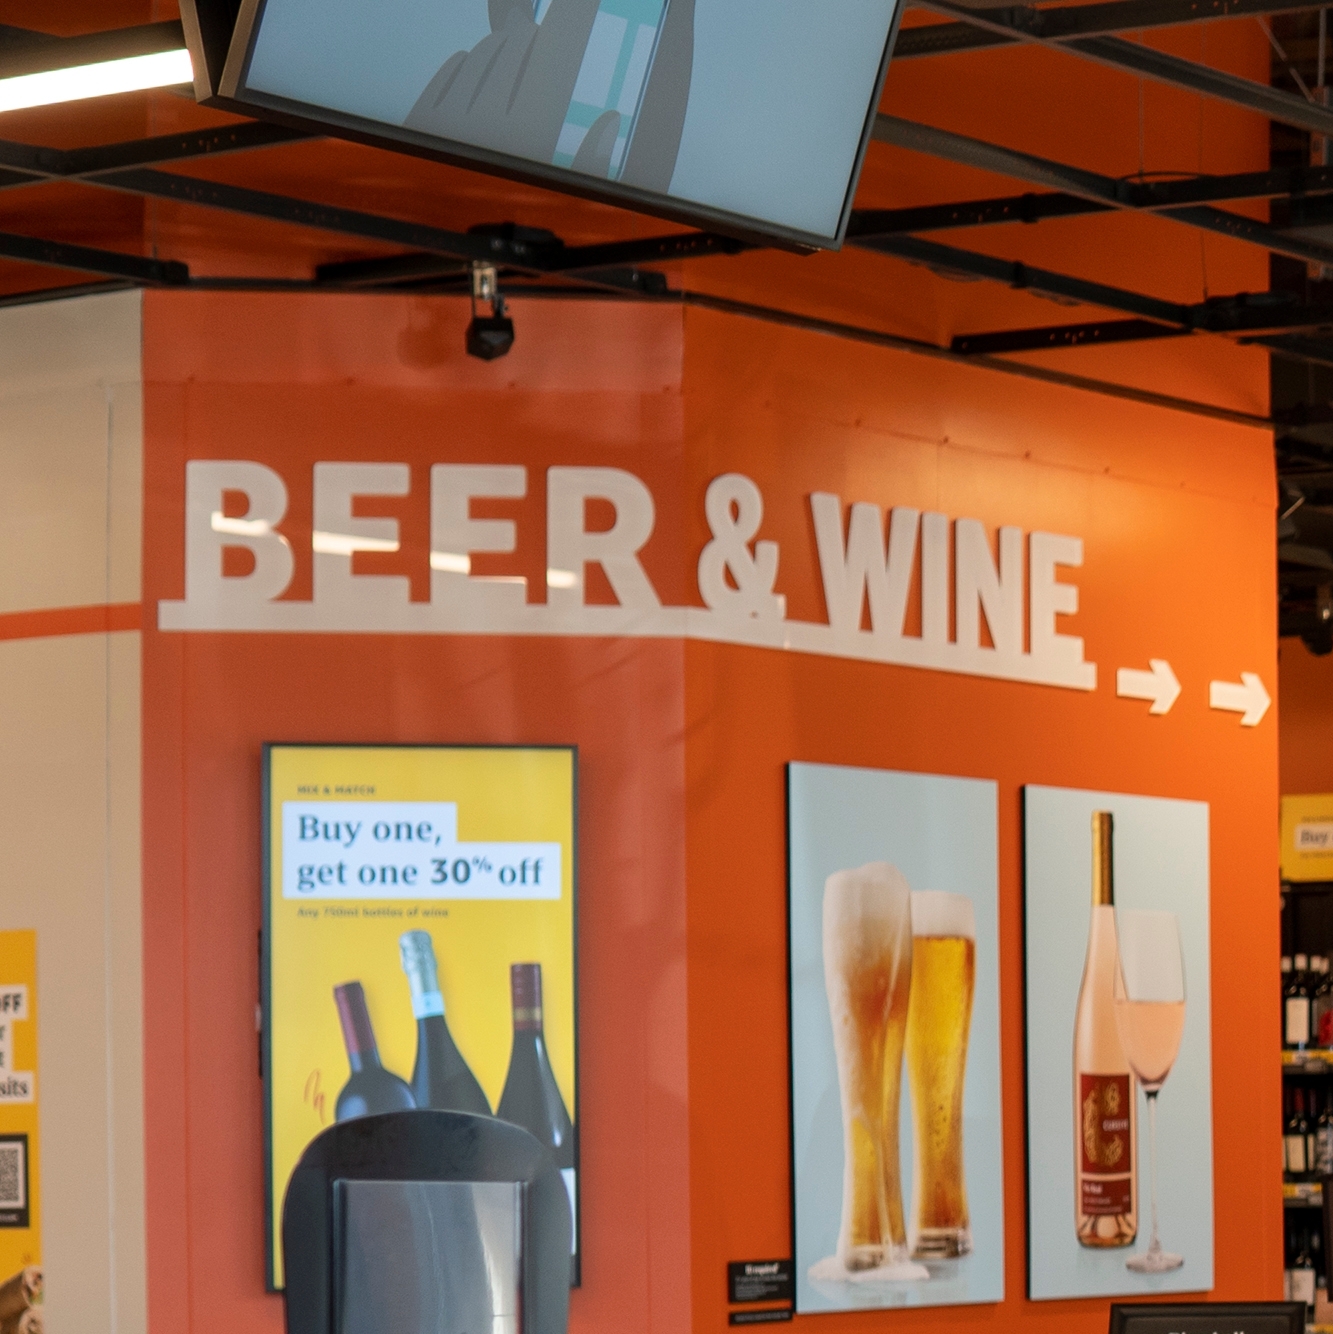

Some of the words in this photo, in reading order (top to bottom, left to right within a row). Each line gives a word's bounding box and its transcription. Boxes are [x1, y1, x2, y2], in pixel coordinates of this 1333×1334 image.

[184, 460, 661, 606] BEER
[697, 471, 779, 612] &
[810, 491, 1084, 658] WINE
[298, 814, 362, 848] Buy
[373, 821, 442, 847] one,
[298, 862, 347, 891] get
[358, 865, 418, 885] one
[430, 857, 492, 885] 30%
[499, 857, 544, 886] off
